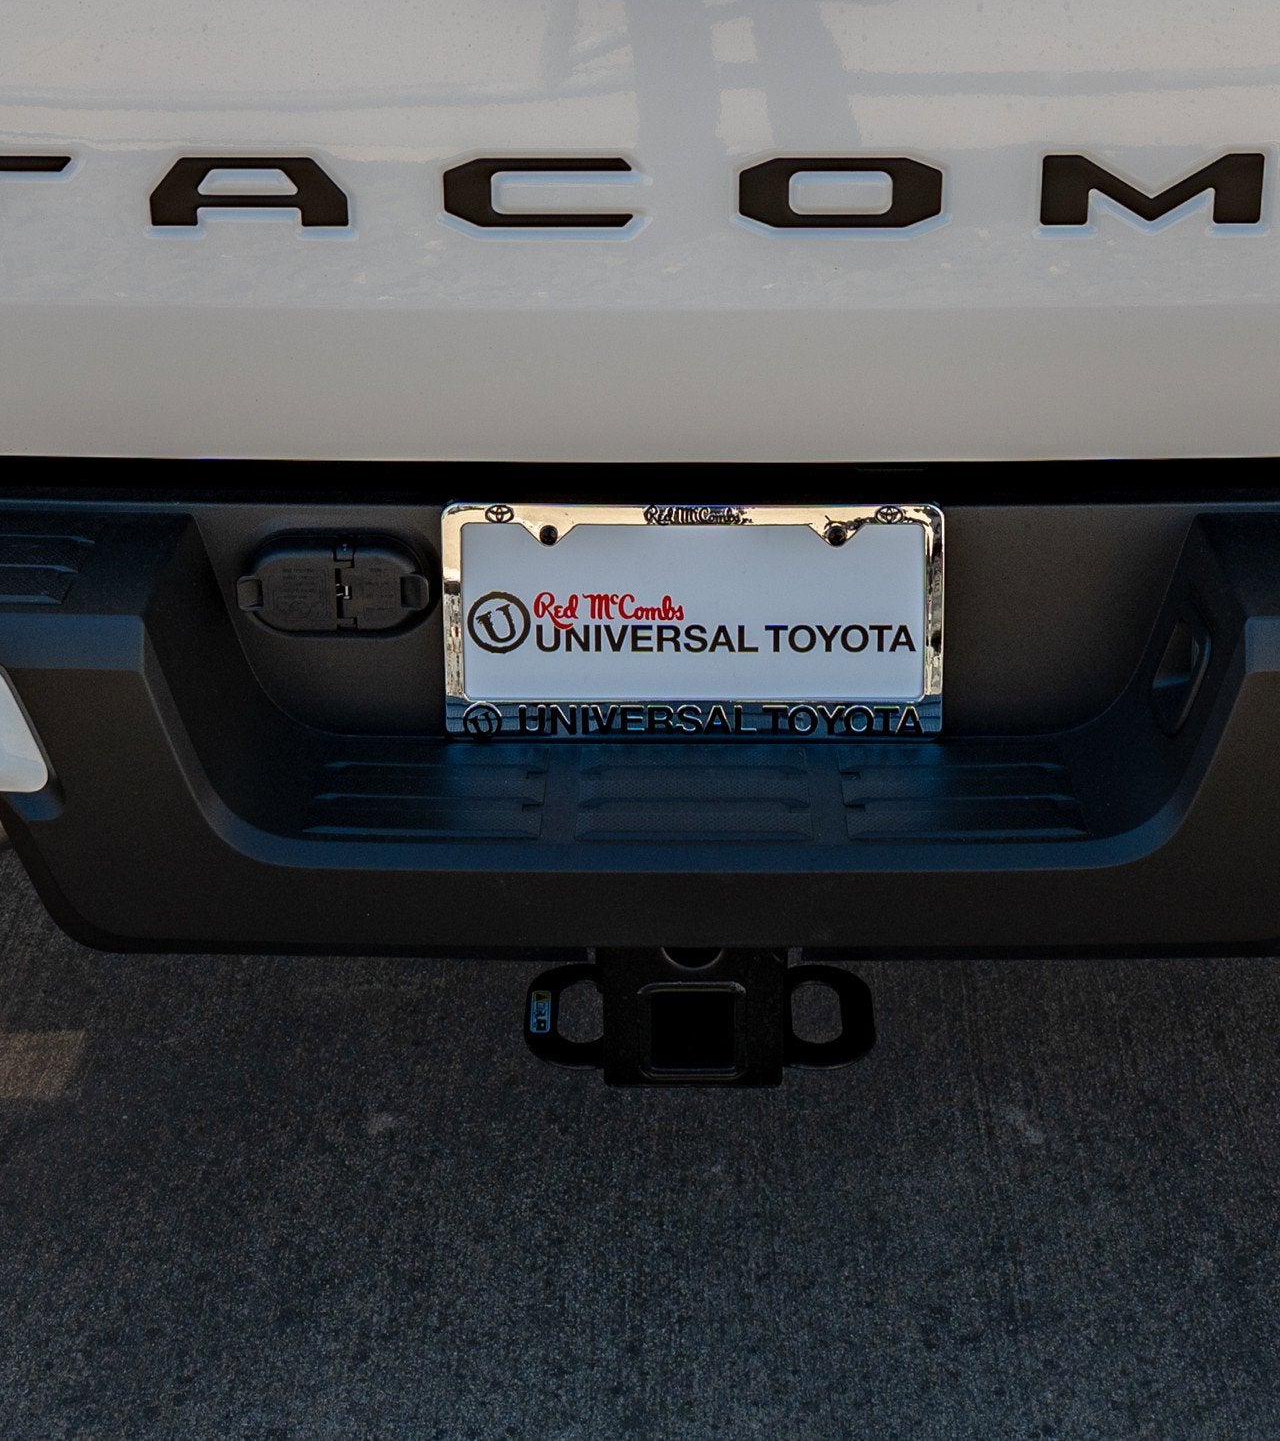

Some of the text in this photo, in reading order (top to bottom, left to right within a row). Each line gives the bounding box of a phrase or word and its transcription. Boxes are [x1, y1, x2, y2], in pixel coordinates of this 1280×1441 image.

[533, 592, 684, 629] Red McCombs
[536, 624, 916, 652] UNIVERSAL TOYOTA
[519, 705, 925, 735] UNIVERSAL TOYOTA
